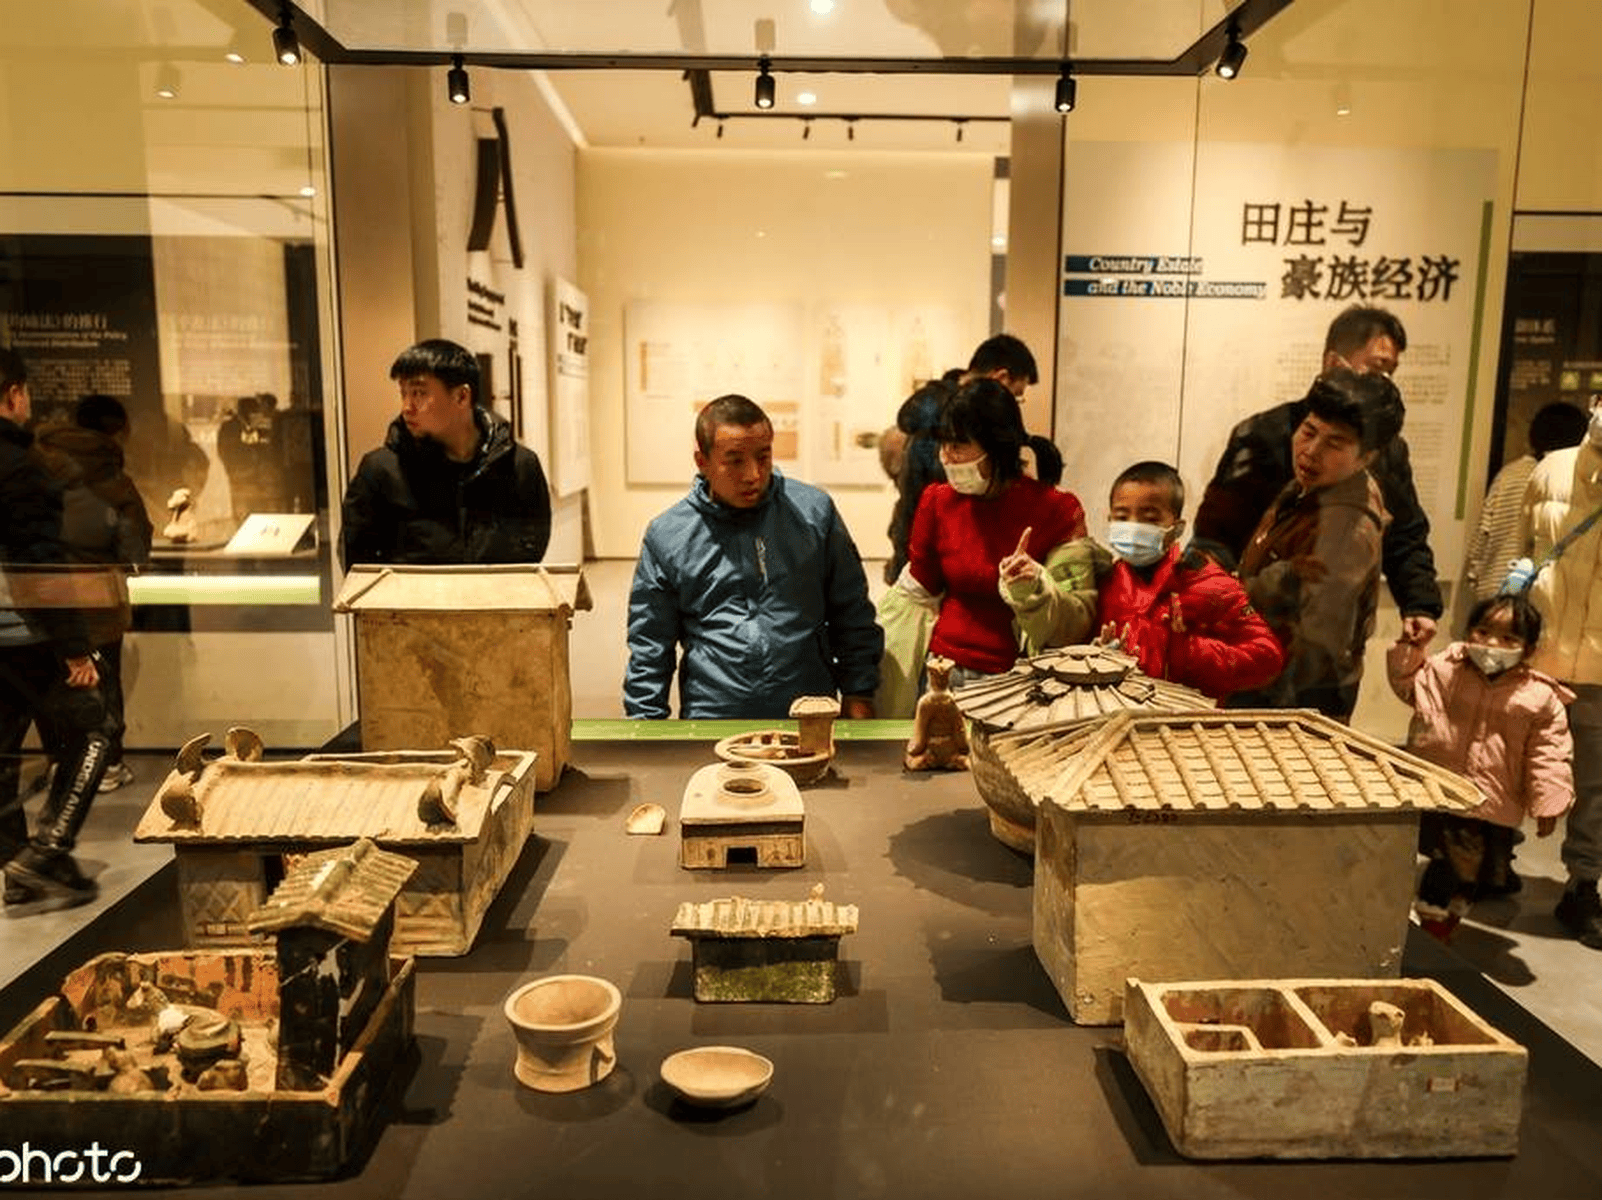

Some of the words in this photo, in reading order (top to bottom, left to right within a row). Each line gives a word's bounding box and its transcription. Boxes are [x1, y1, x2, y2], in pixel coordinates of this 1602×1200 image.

[1242, 200, 1372, 246] 田庄与
[1089, 256, 1154, 275] Country
[1281, 254, 1459, 301] 豪族经济
[1121, 280, 1148, 295] the
